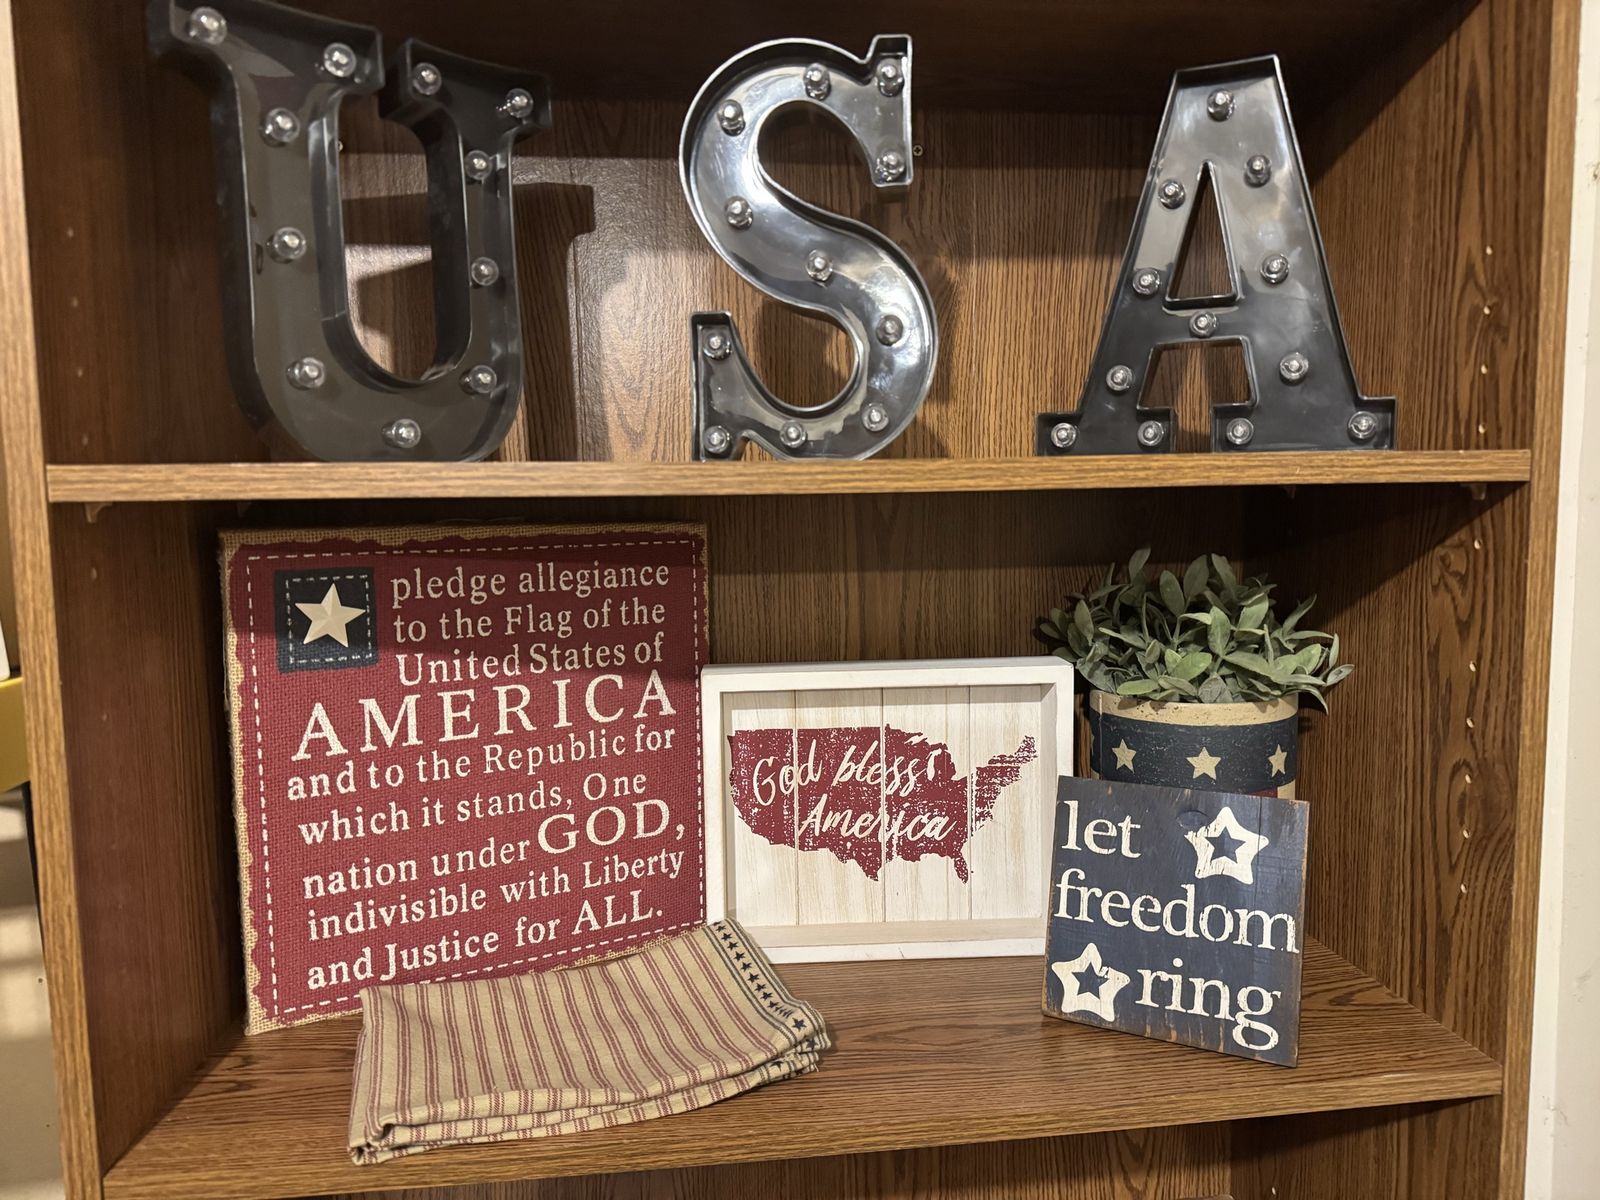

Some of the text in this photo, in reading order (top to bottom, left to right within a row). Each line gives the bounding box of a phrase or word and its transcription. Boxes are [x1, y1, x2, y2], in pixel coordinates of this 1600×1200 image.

[391, 560, 670, 609] pledge allegiance
[393, 597, 666, 644] to the Flag of the
[396, 632, 665, 686] United States of
[290, 669, 677, 762] AMERICA
[286, 724, 676, 801] and to the Republic for
[752, 739, 927, 806] God bless
[298, 771, 647, 846] which it stands, One
[797, 793, 957, 844] America
[1061, 800, 1141, 858] let
[302, 798, 686, 900] nation under GOD,
[307, 846, 686, 941] indivisible with Liberty
[1053, 868, 1300, 954] freedom
[307, 889, 664, 990] and Justice for ALL.
[1135, 957, 1282, 1051] ring
